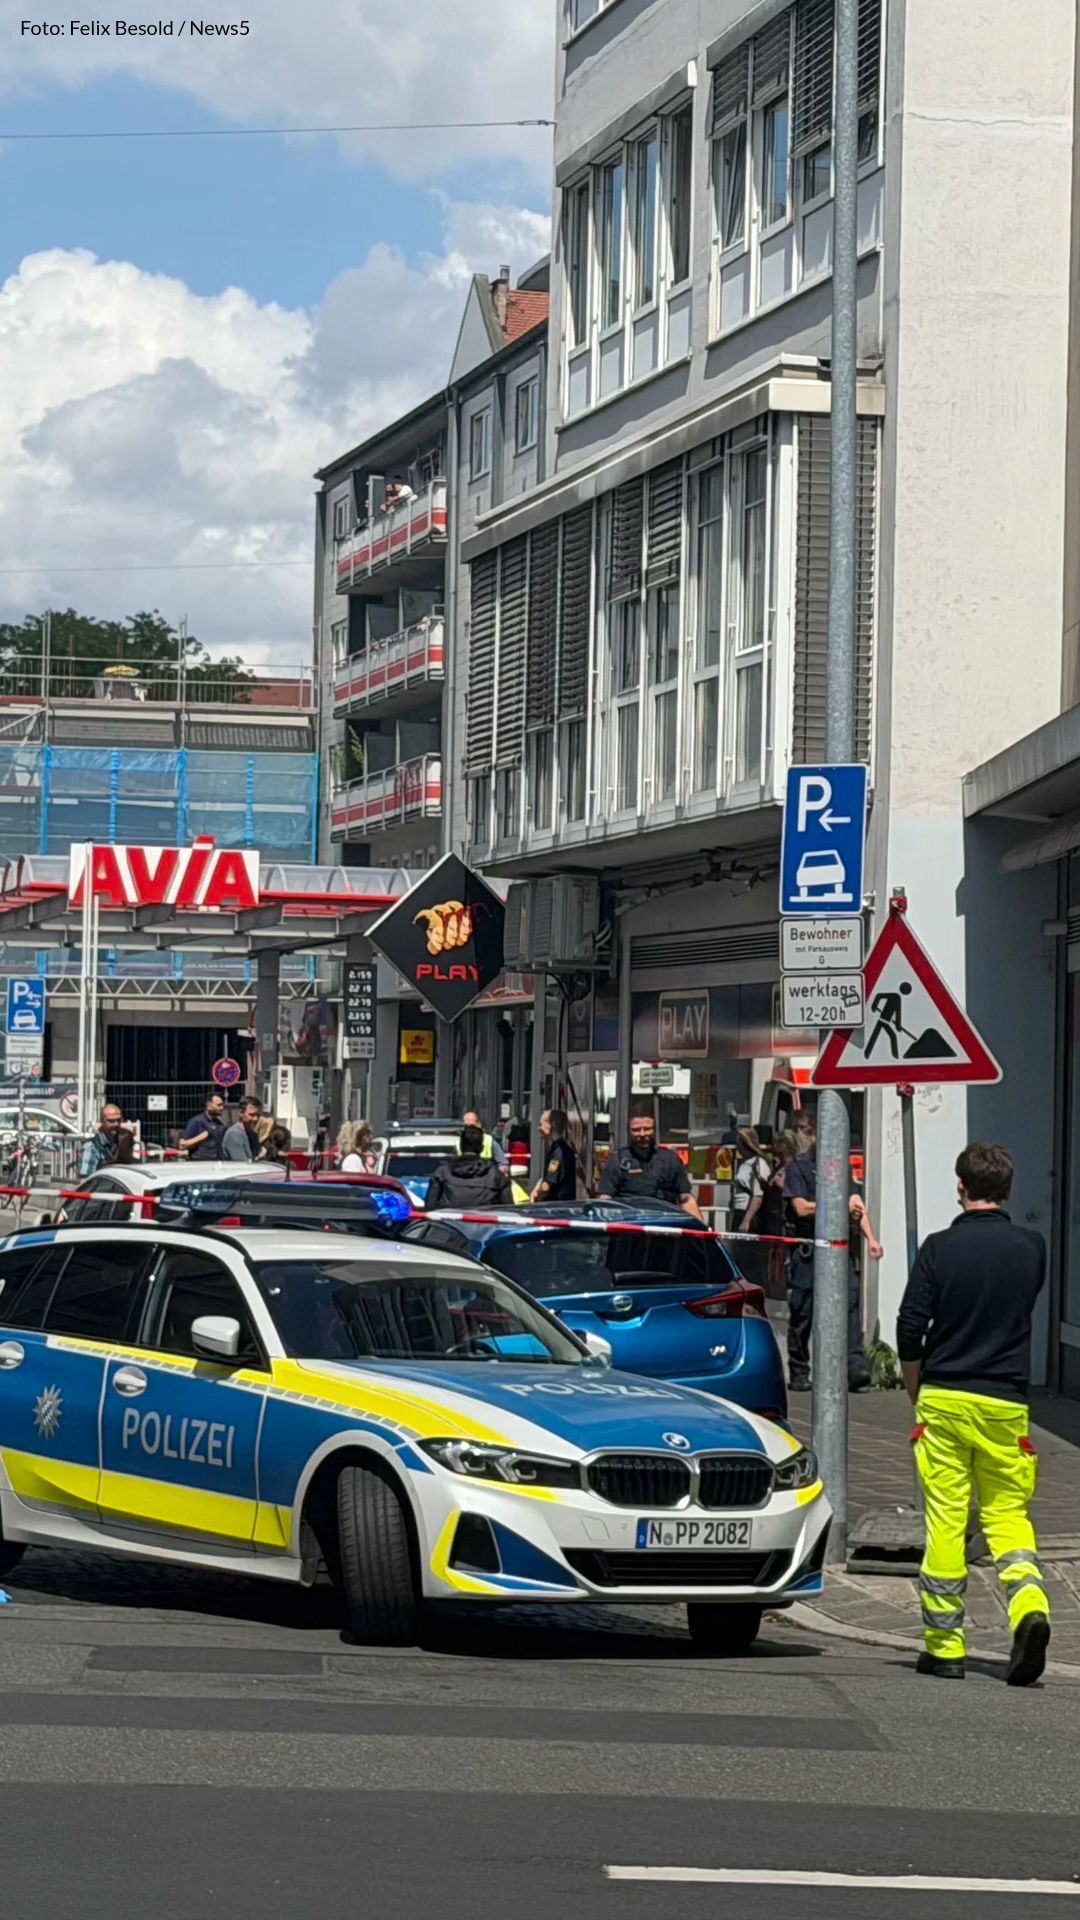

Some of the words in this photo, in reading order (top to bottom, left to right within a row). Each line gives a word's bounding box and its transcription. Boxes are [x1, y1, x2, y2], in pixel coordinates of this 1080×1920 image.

[797, 776, 833, 832] P
[68, 834, 258, 906] AVIA
[790, 927, 853, 941] Bewohner
[14, 981, 30, 1005] P
[789, 982, 857, 999] werktags
[662, 1004, 706, 1042] PLAY
[501, 1383, 684, 1400] POLIZEI
[122, 1407, 235, 1468] POLIZEI
[649, 1522, 662, 1545] N
[675, 1522, 700, 1545] PP
[703, 1522, 749, 1545] 2082
